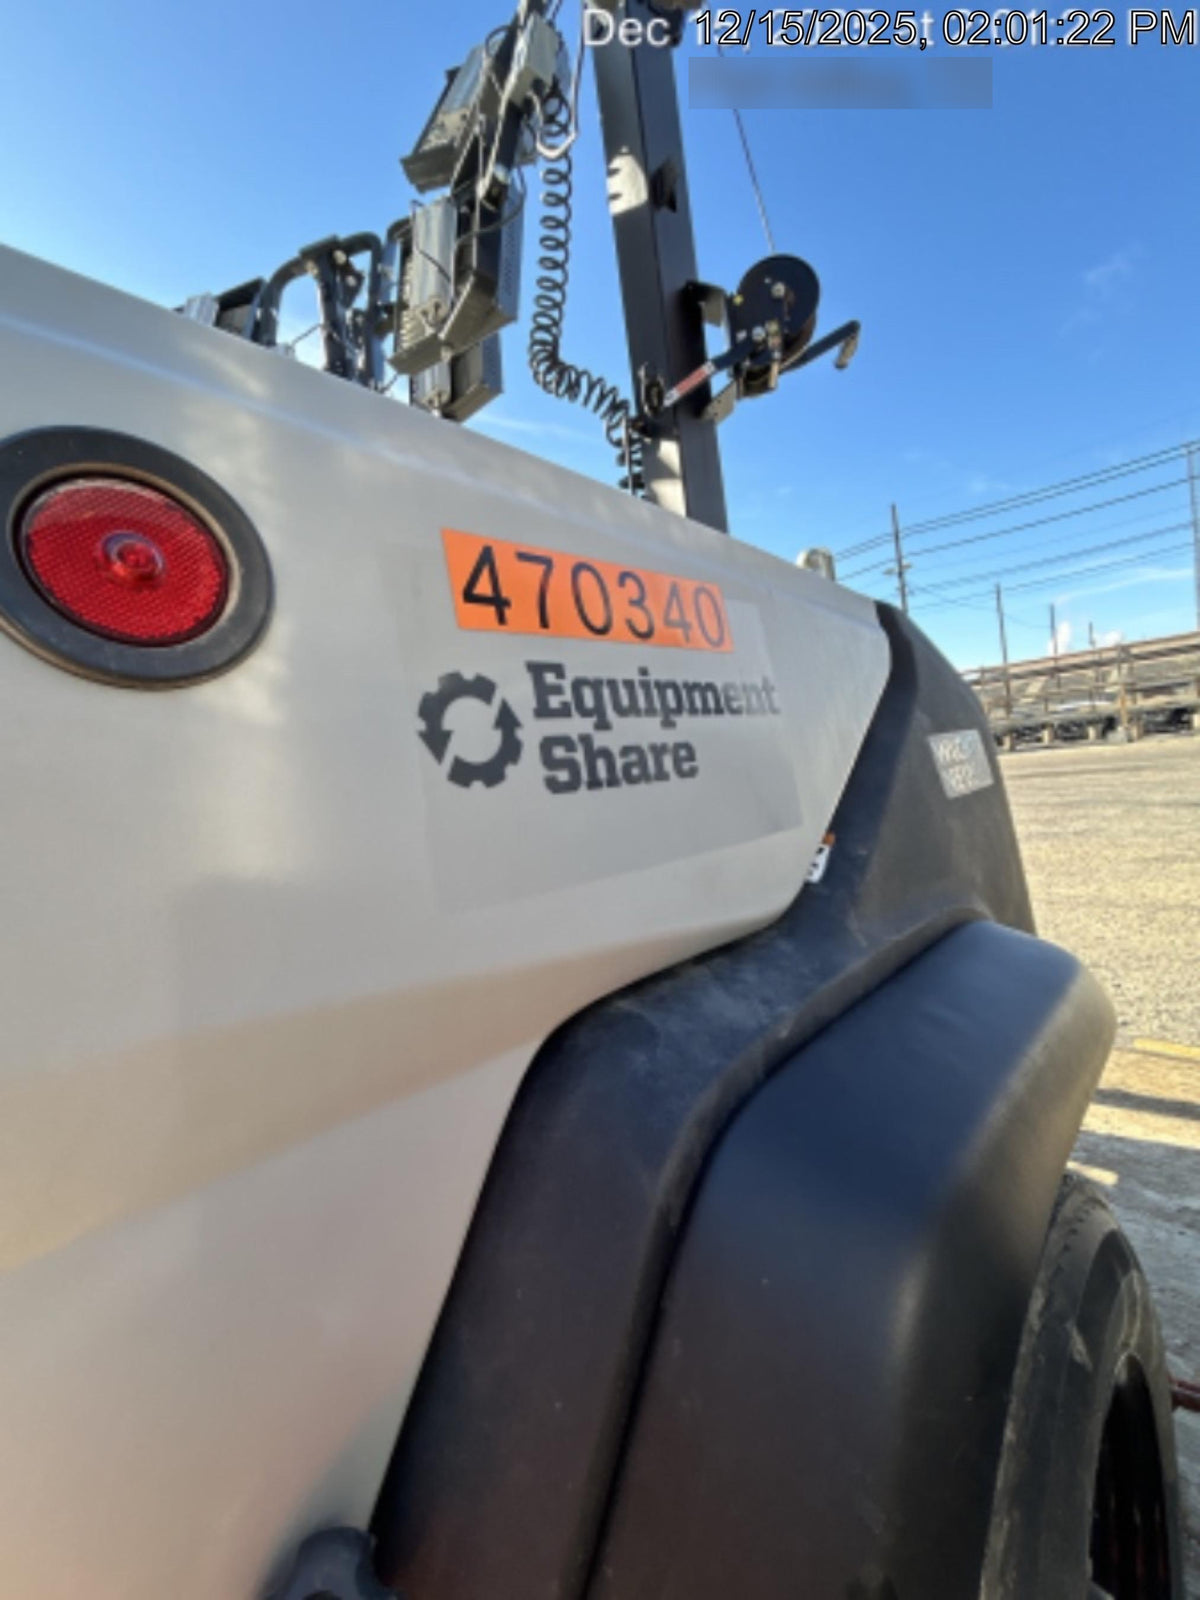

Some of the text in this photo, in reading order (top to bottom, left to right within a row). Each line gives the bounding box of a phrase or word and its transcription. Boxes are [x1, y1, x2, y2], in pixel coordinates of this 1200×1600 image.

[462, 545, 724, 648] 470340
[525, 660, 780, 731] Equipment
[539, 733, 699, 794] Share
